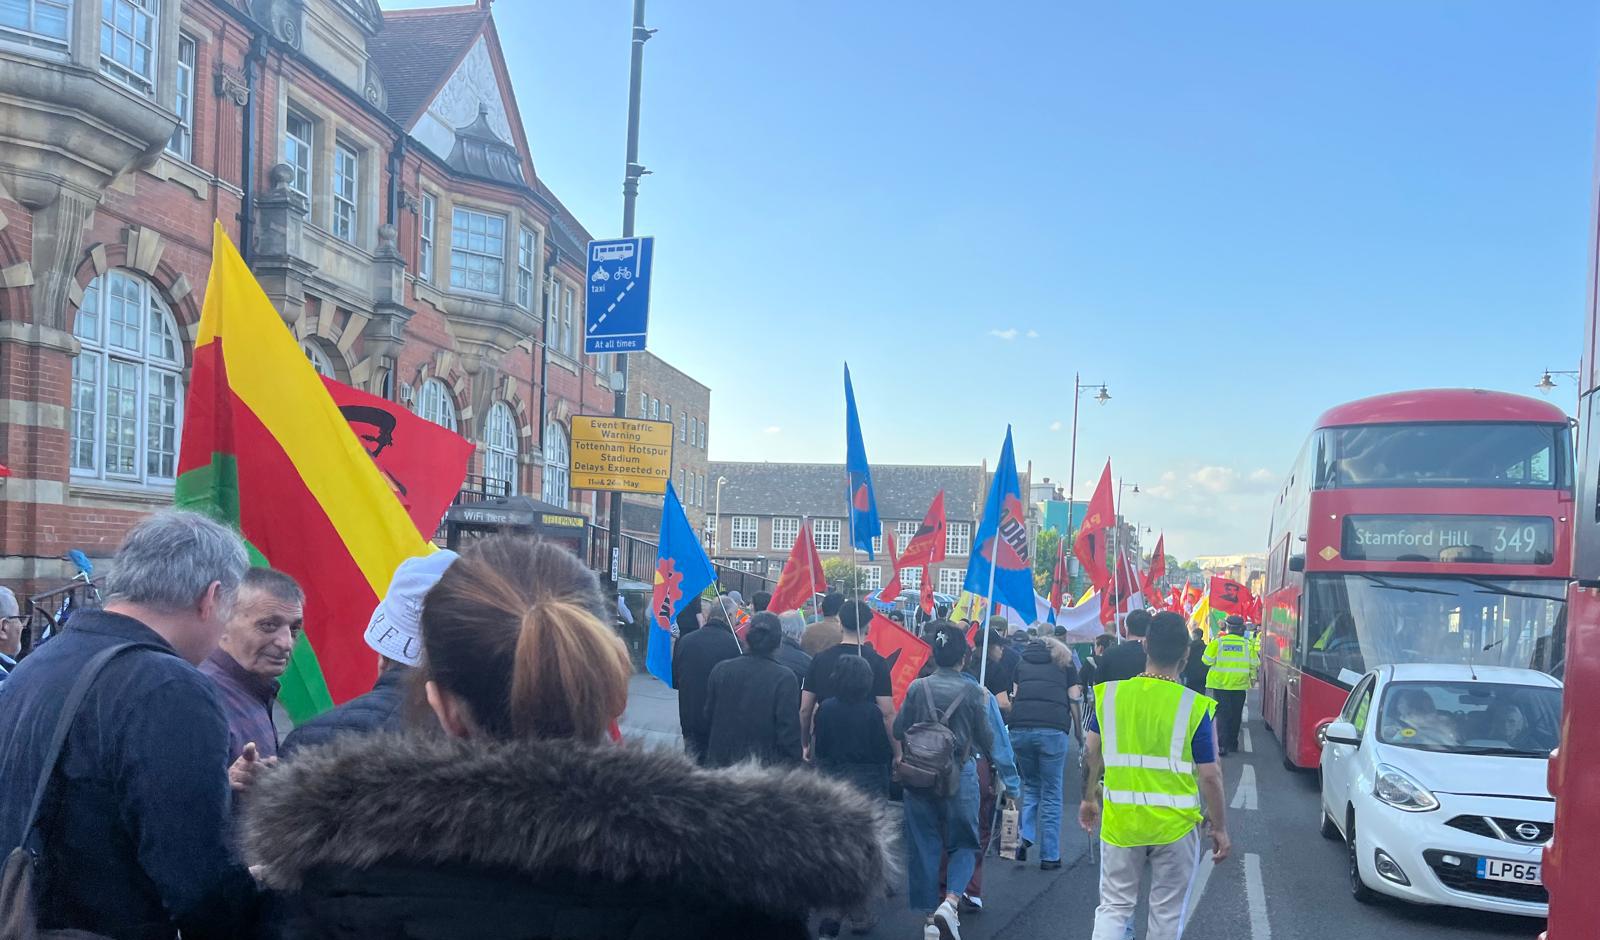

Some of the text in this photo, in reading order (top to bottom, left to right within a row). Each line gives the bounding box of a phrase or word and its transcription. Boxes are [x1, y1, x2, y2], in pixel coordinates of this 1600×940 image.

[591, 284, 606, 292] taxi
[605, 340, 614, 348] all
[616, 340, 636, 348] times
[590, 420, 653, 432] Event Traffic
[601, 430, 641, 441] Warning
[575, 441, 668, 456] Tottenham Hotspur
[600, 453, 640, 463] Stadium
[574, 462, 604, 472] Delays
[608, 464, 652, 476] Expected
[623, 479, 640, 488] May
[463, 511, 484, 521] WiFi
[486, 512, 506, 522] here
[1355, 525, 1536, 553] Stamford Hill 349
[1488, 861, 1537, 881] LP65
